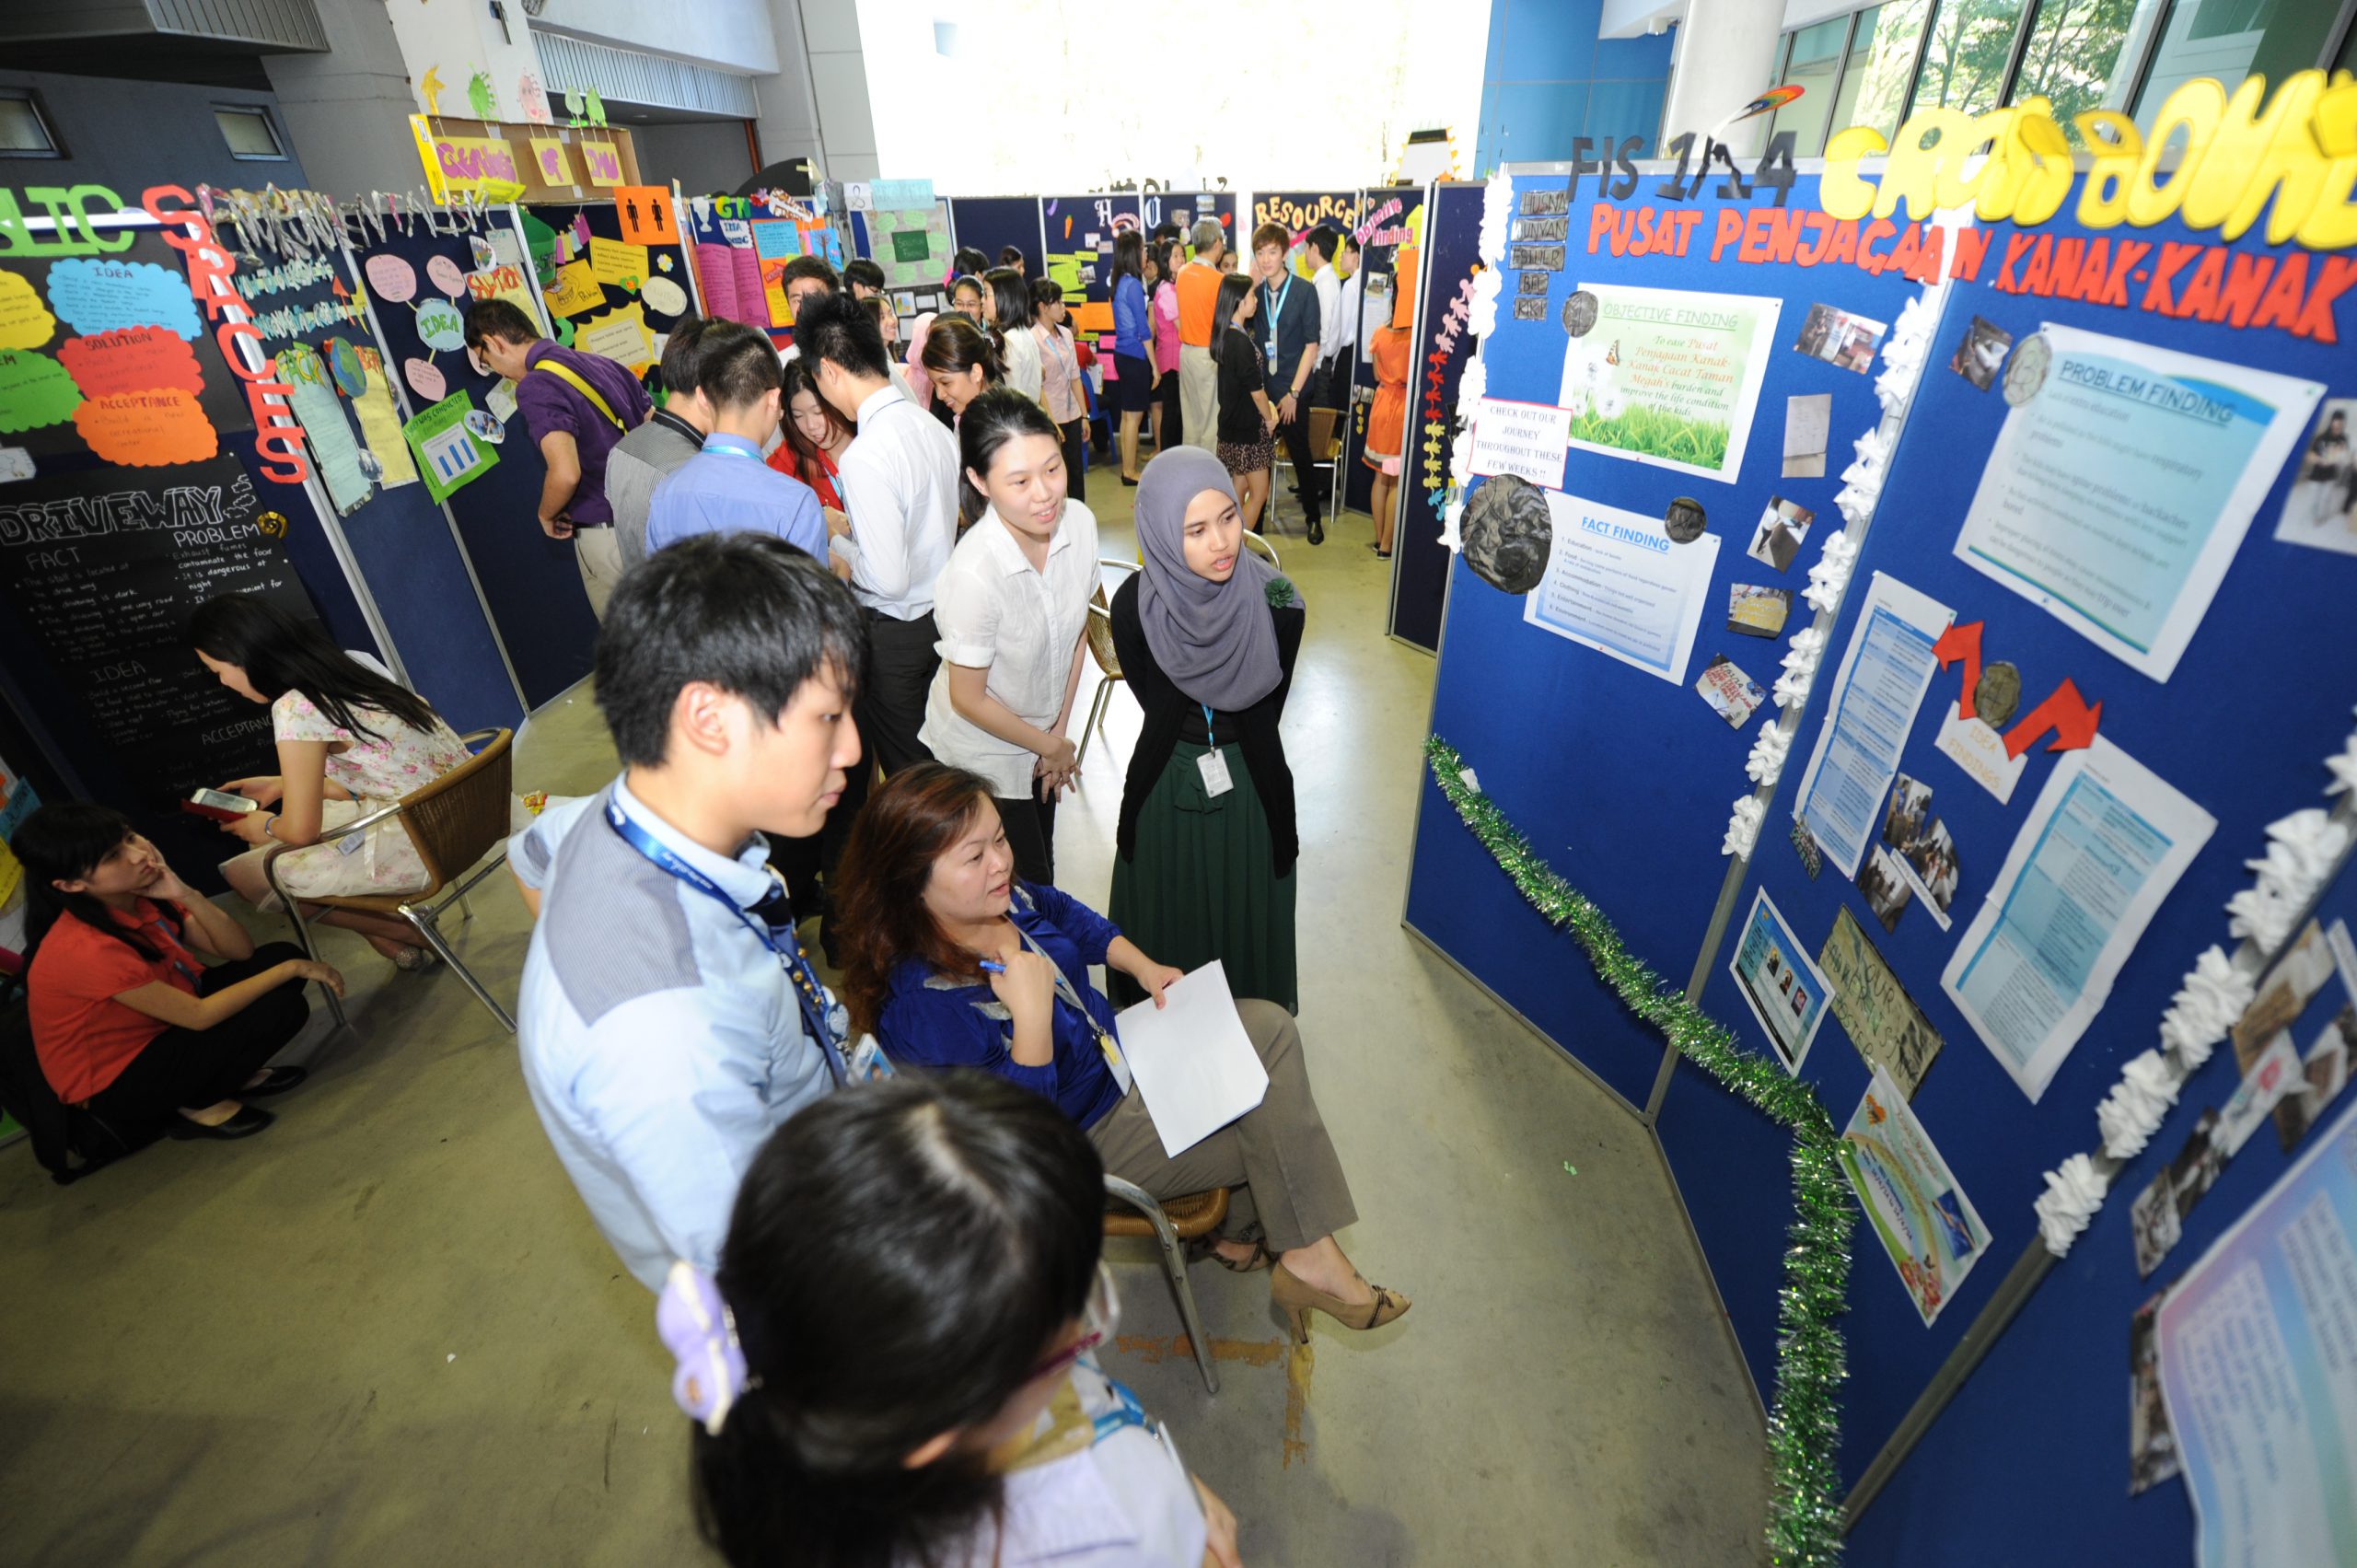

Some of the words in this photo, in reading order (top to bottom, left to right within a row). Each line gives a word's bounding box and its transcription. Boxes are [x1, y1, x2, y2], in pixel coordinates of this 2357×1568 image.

[1566, 135, 1644, 203] FIS
[1523, 192, 1566, 214] HUSNA
[93, 267, 133, 278] IDEA
[1587, 203, 1702, 258] PUSAT
[1710, 207, 1993, 285] PENJAGAAN
[1996, 231, 2357, 343] KANAK-KANAK
[420, 314, 459, 339] IDEA
[1604, 304, 1672, 321] OBJECTIVE
[1677, 309, 1738, 328] FINDING
[86, 333, 152, 351] SOLUTION
[99, 396, 181, 410] ACCEPTANCE
[1620, 386, 1653, 400] improve
[1655, 389, 1668, 400] the
[1686, 397, 1729, 411] condition
[2061, 360, 2145, 395] PROBLEM
[2145, 381, 2238, 423] FINDING
[1490, 406, 1518, 418] CHECK
[1521, 411, 1537, 421] OUT
[1538, 413, 1557, 424] OUR
[1658, 403, 1672, 412] the
[1502, 425, 1540, 441] JOURNEY
[1487, 459, 1507, 471] FEW
[1508, 463, 1538, 477] WEEKS
[1535, 450, 1562, 463] THESE
[173, 524, 260, 548] PROBLEM
[1581, 517, 1610, 534] FACT
[1613, 525, 1670, 552] FINDING
[26, 547, 80, 571] FACT
[208, 563, 250, 576] dangerous
[189, 581, 211, 592] night
[89, 660, 146, 684] IDEA
[201, 714, 273, 745] ACCEPTANC
[1866, 964, 1894, 1014] OUR
